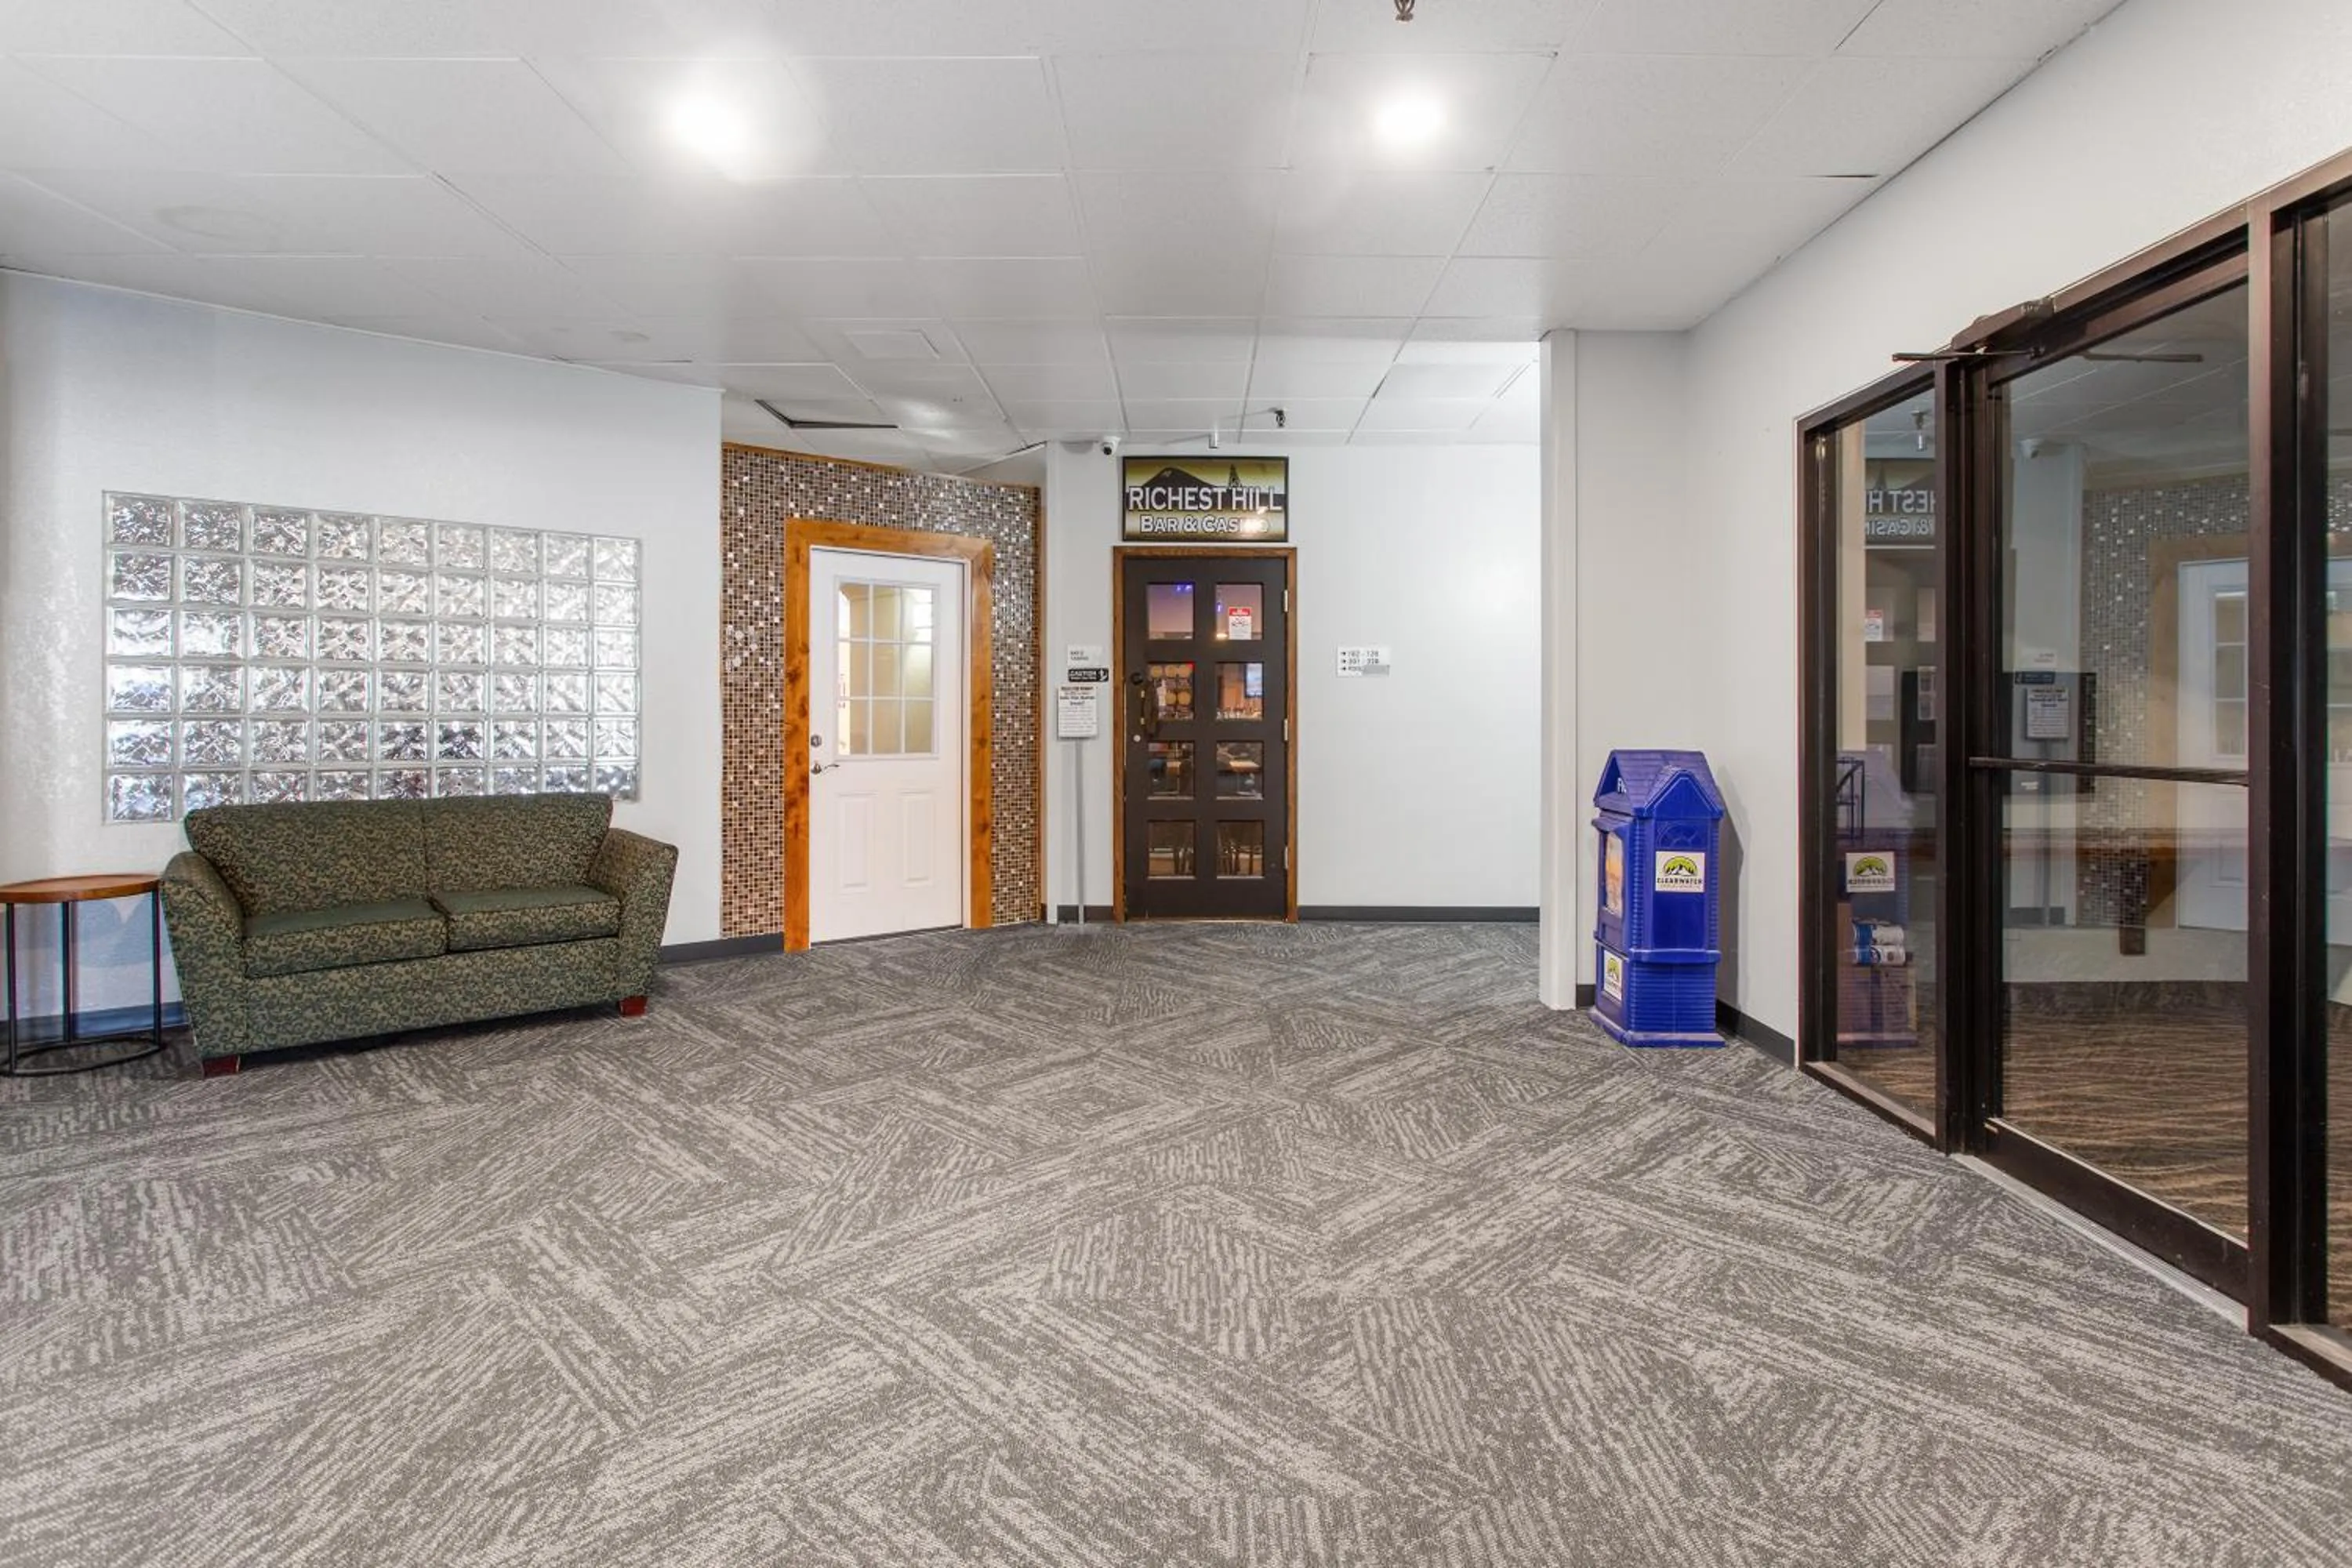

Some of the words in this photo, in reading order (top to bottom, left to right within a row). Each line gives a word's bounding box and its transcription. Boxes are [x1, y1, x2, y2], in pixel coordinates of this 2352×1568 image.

[1127, 486, 1227, 511] RICHEST
[1231, 486, 1283, 511] HILL
[1140, 514, 1178, 533] BAR
[1182, 515, 1198, 533] &
